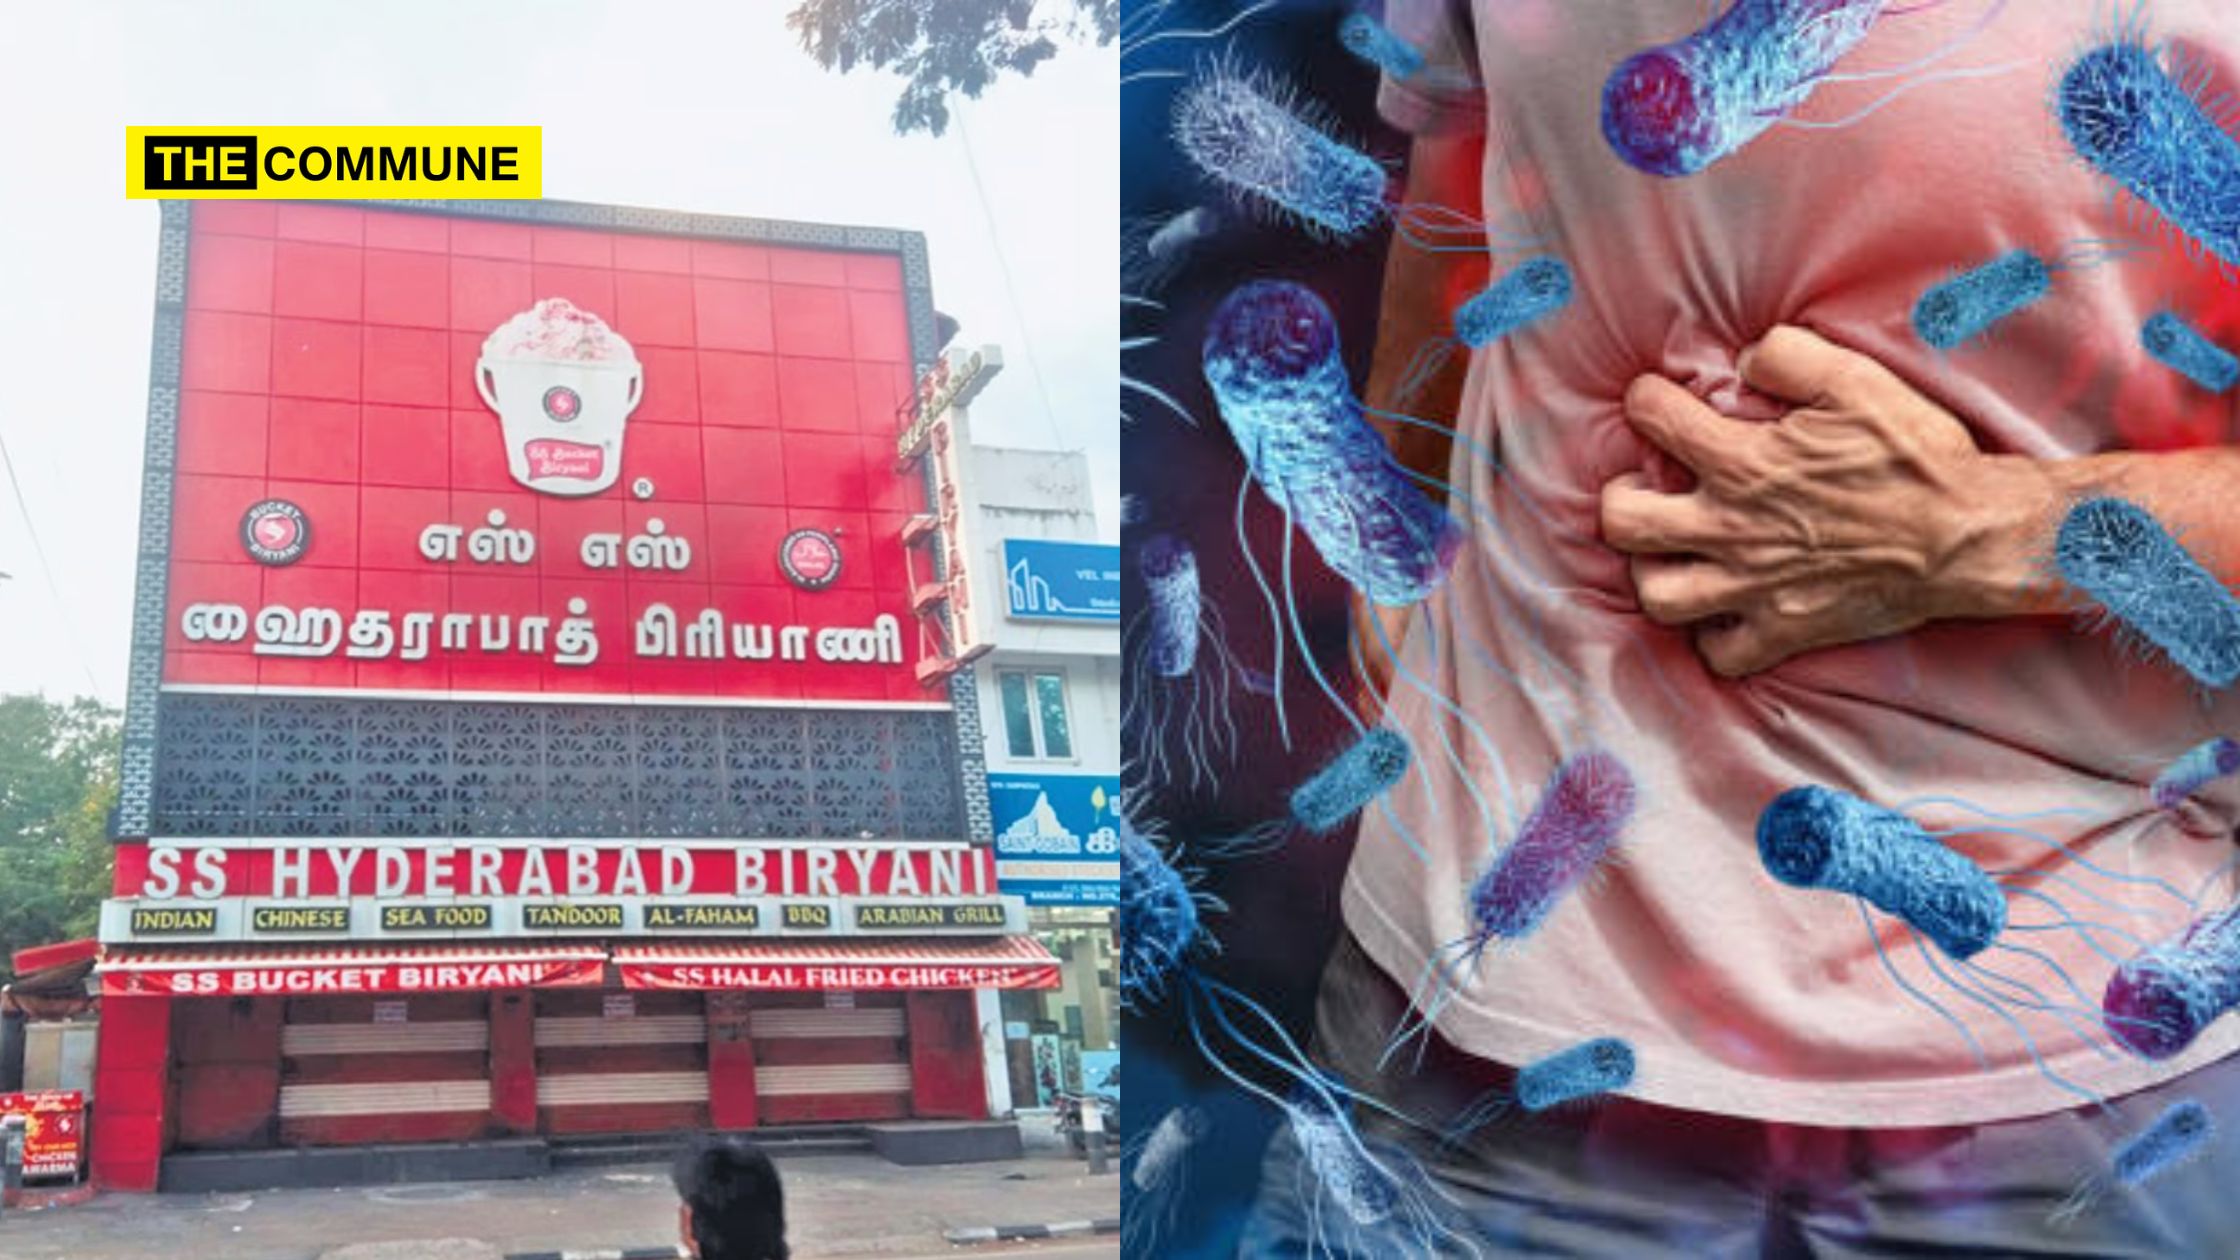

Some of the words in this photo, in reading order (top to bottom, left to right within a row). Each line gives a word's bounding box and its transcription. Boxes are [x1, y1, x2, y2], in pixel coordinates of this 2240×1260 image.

[249, 502, 302, 519] BUCKET
[418, 508, 536, 564] எஸ்
[580, 517, 692, 571] எஸ்
[181, 596, 600, 665] ஹைதராபாத்
[635, 603, 903, 664] பிரியாணி
[143, 847, 228, 900] SS
[271, 846, 696, 900] HYDERABAD
[734, 846, 988, 897] BIRYANI
[134, 909, 214, 929] INDIAN
[255, 909, 347, 929] CHINESE
[385, 907, 427, 927] SEA
[435, 907, 488, 926] FOOD
[527, 905, 622, 926] TANDOOR
[649, 906, 755, 926] AL-FAHAM
[787, 906, 828, 926] BBQ
[859, 906, 945, 925] ARABIAN
[953, 906, 1003, 924] GRILL
[171, 972, 221, 993] SS
[231, 968, 387, 992] BUCKET
[399, 963, 546, 989] BIRYANI
[673, 967, 706, 986] SS
[711, 967, 799, 987] HALAL
[806, 967, 885, 987] FRIED
[889, 966, 1012, 987] CHICKEN
